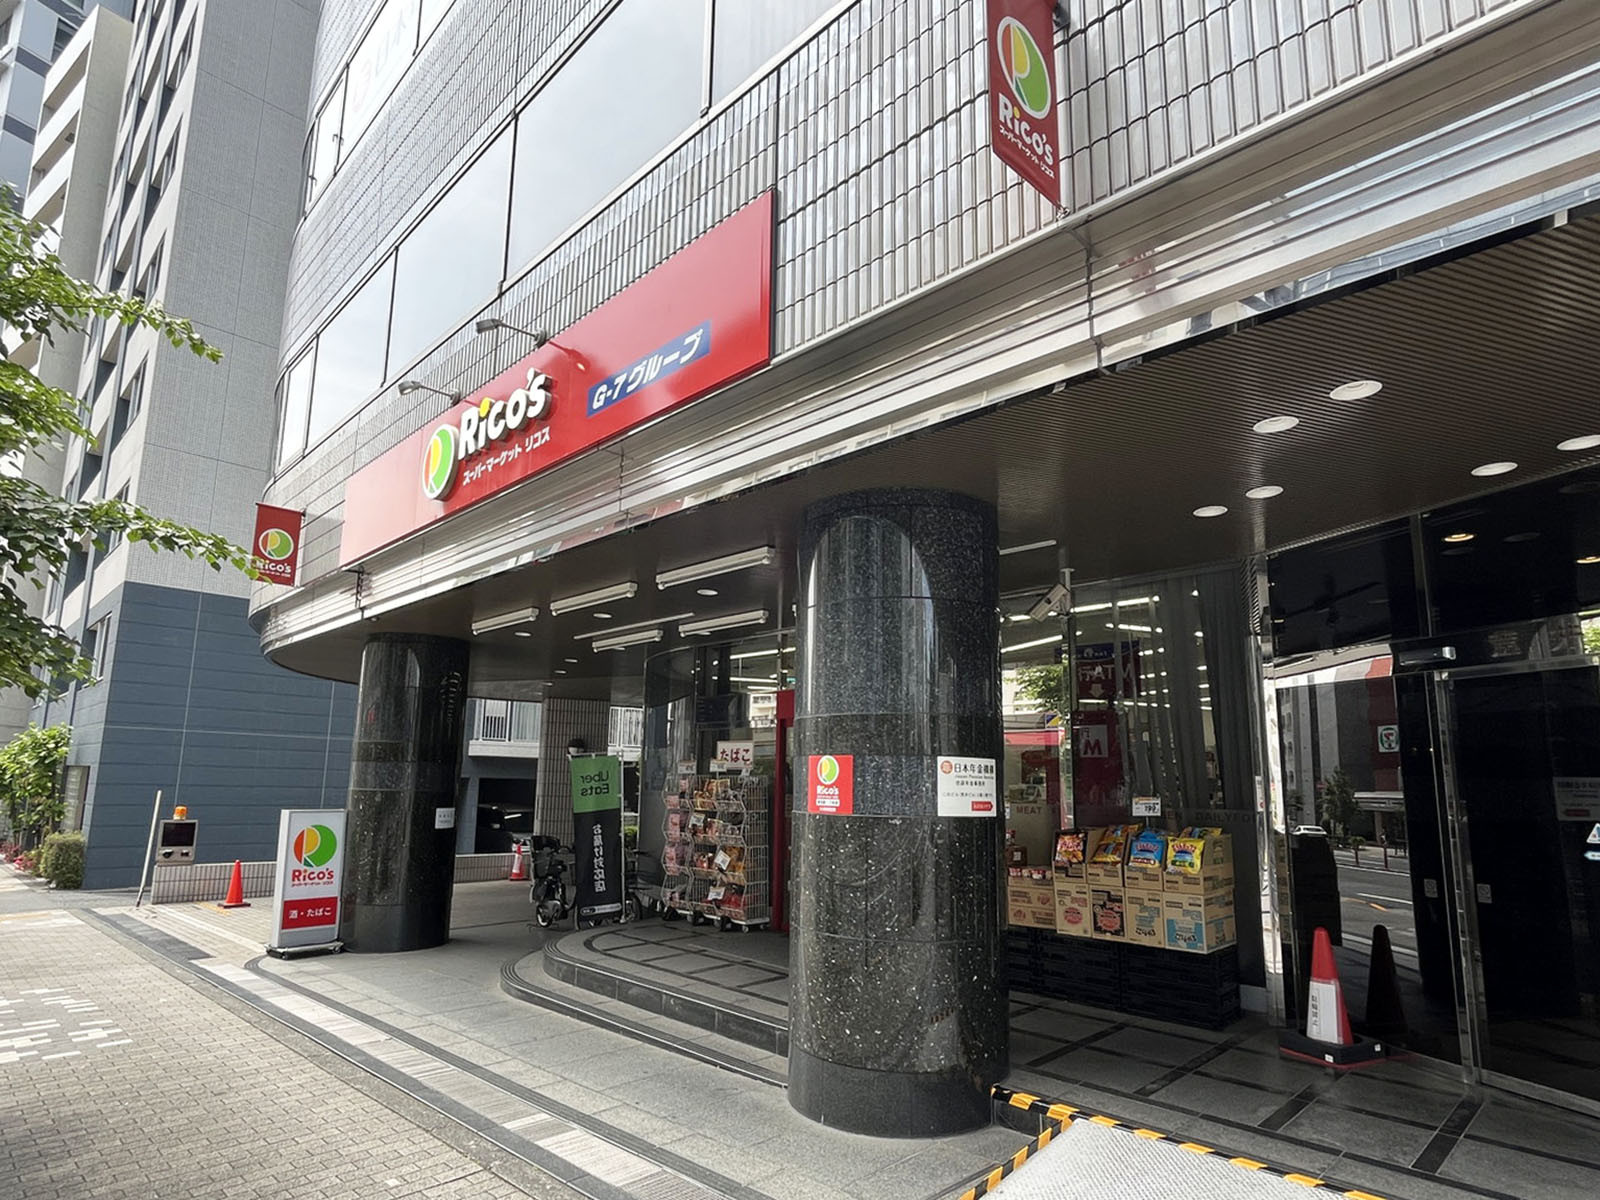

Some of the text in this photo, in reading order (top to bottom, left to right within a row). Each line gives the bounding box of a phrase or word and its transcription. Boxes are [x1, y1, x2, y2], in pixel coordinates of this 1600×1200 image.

[998, 92, 1055, 166] Rico's
[458, 367, 548, 460] Rico's
[463, 426, 550, 486] スーパーマーケット リコス
[719, 748, 750, 763] たばこ
[1016, 806, 1042, 814] MEAT
[291, 867, 334, 883] Rico's
